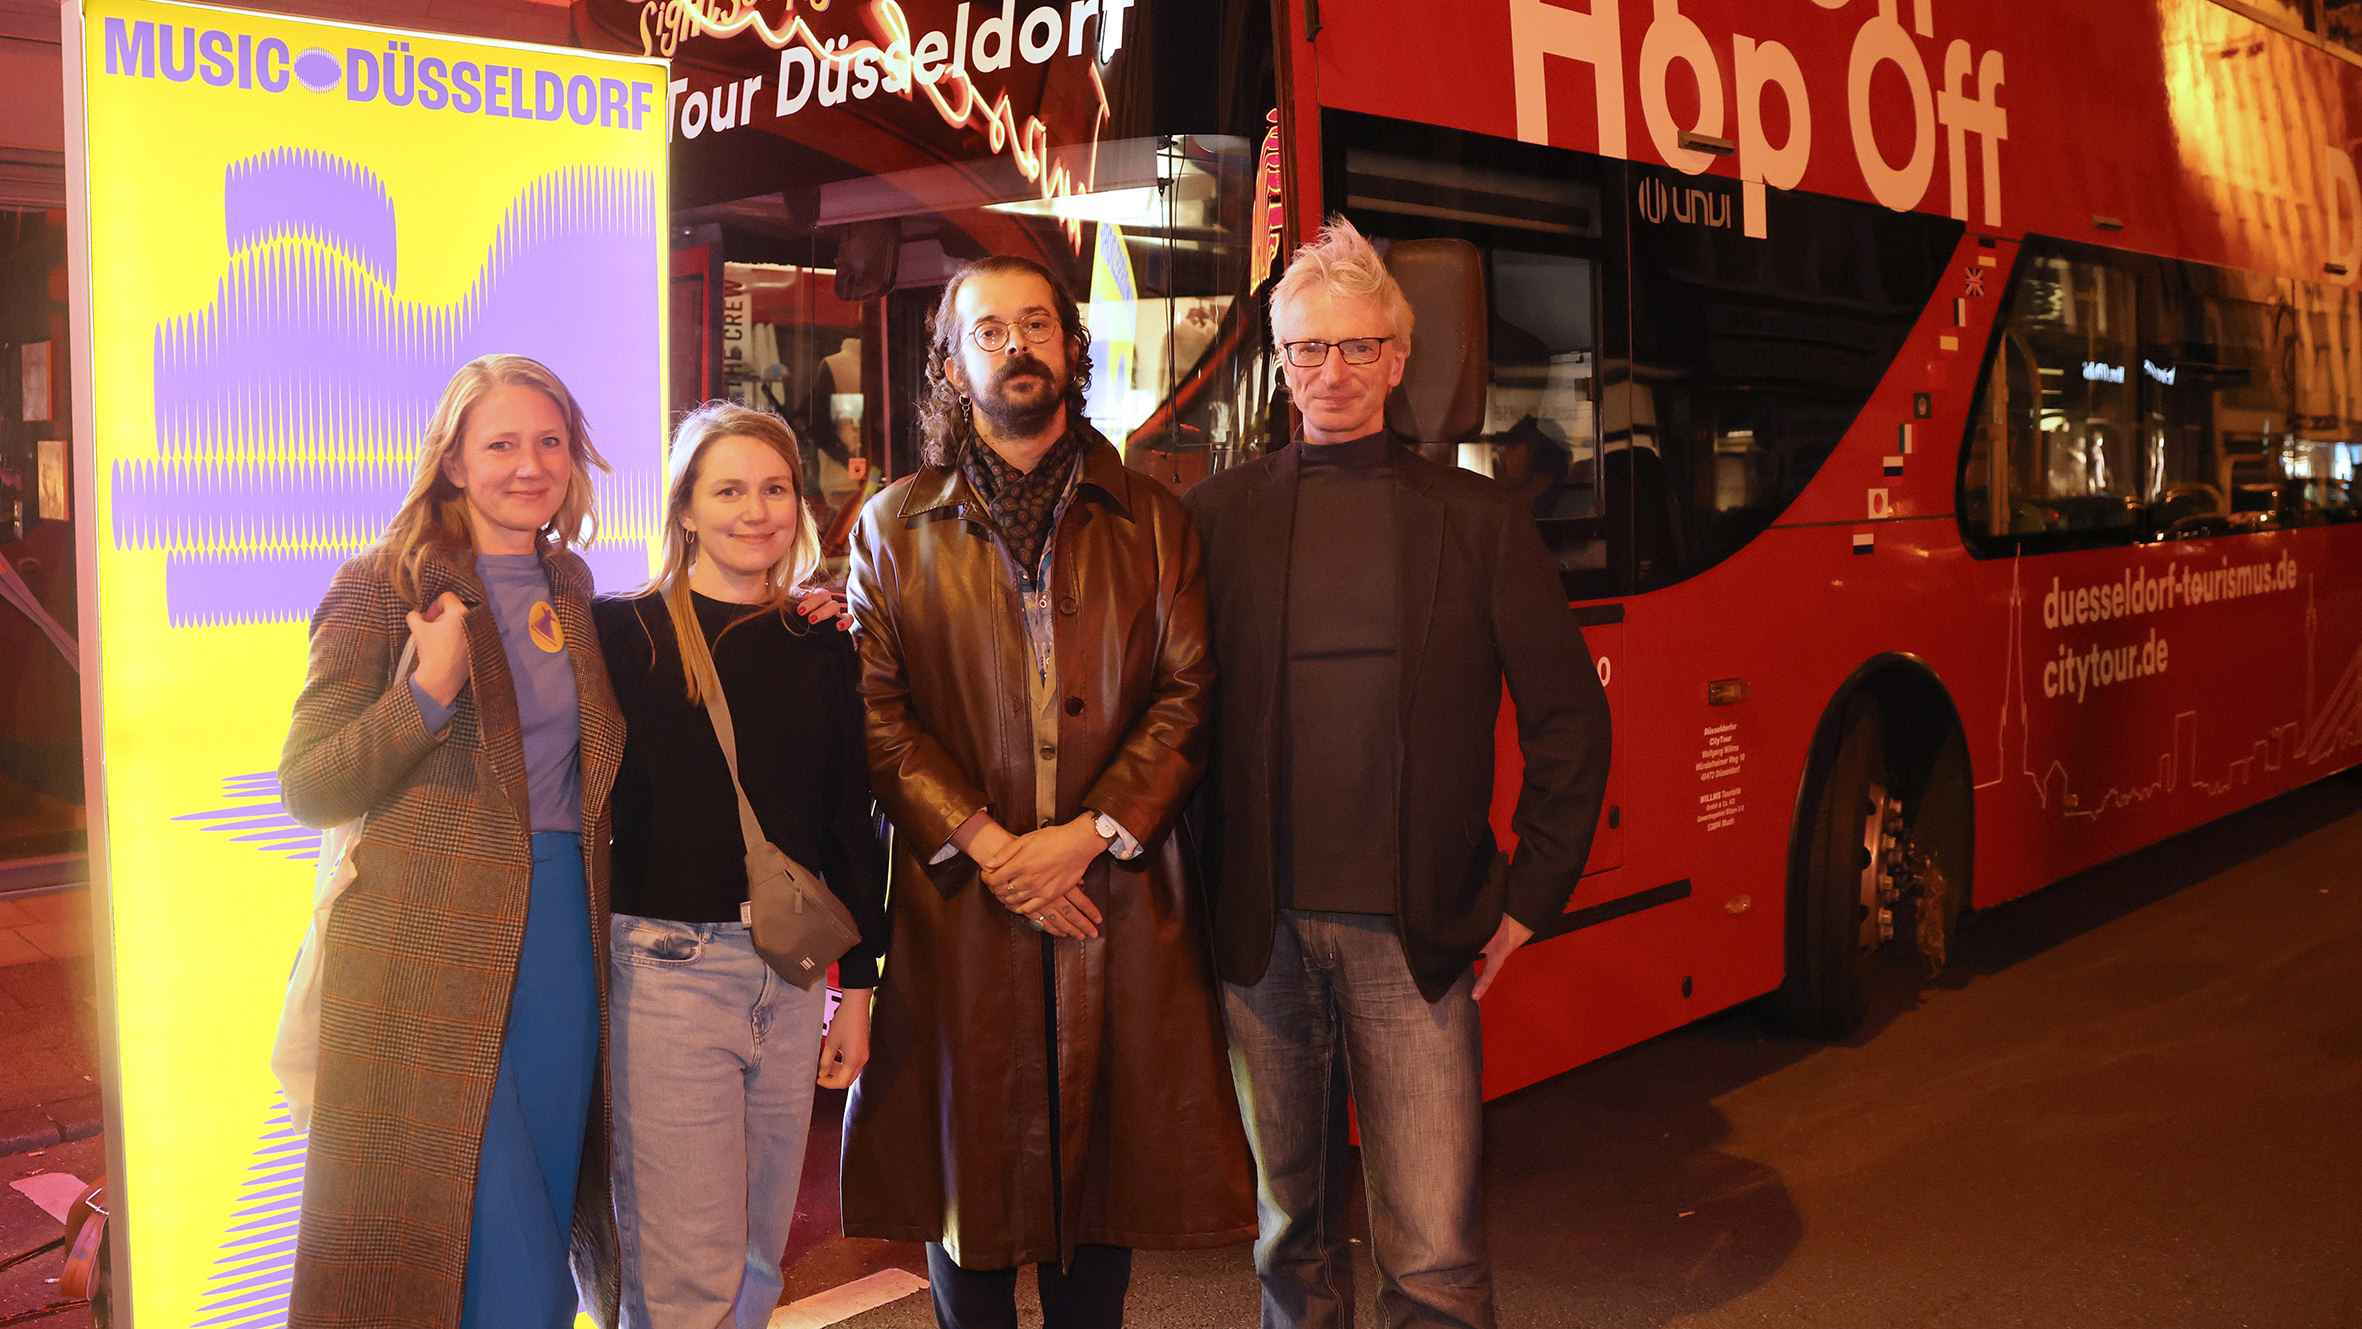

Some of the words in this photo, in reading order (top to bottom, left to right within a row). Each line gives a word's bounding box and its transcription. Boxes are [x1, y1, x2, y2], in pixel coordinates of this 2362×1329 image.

[105, 17, 291, 93] MUSIC
[346, 40, 654, 131] DÜSSELDORF
[669, 75, 762, 144] Tour
[776, 0, 1135, 118] Düsseldorf
[1509, 0, 1812, 239] Hop
[1848, 15, 2008, 227] Off
[724, 280, 743, 341] CREW
[2043, 549, 2297, 629] duesseldorf-tourismus.de
[2043, 627, 2169, 704] citytour.de
